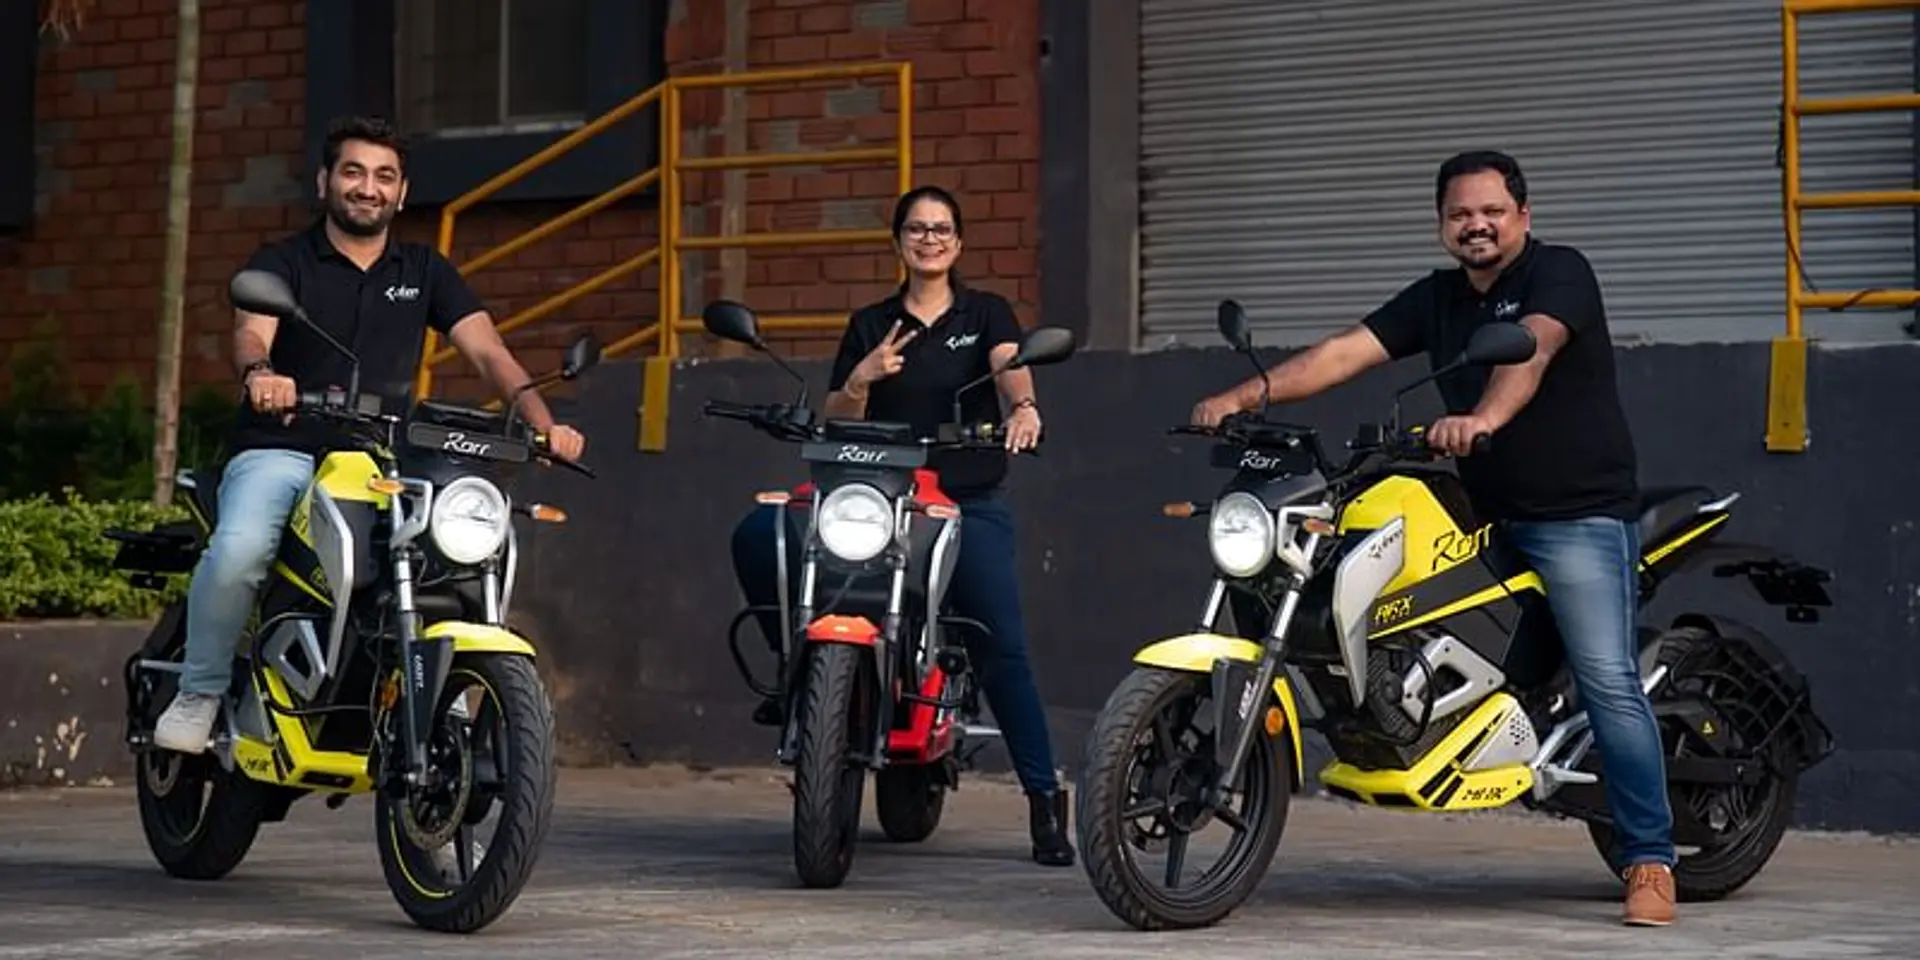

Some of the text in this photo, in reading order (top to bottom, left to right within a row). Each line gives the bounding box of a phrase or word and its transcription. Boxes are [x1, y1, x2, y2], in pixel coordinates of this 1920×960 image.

[443, 432, 490, 455] Rorr
[837, 444, 888, 463] Rorr
[1431, 523, 1493, 572] Rorr
